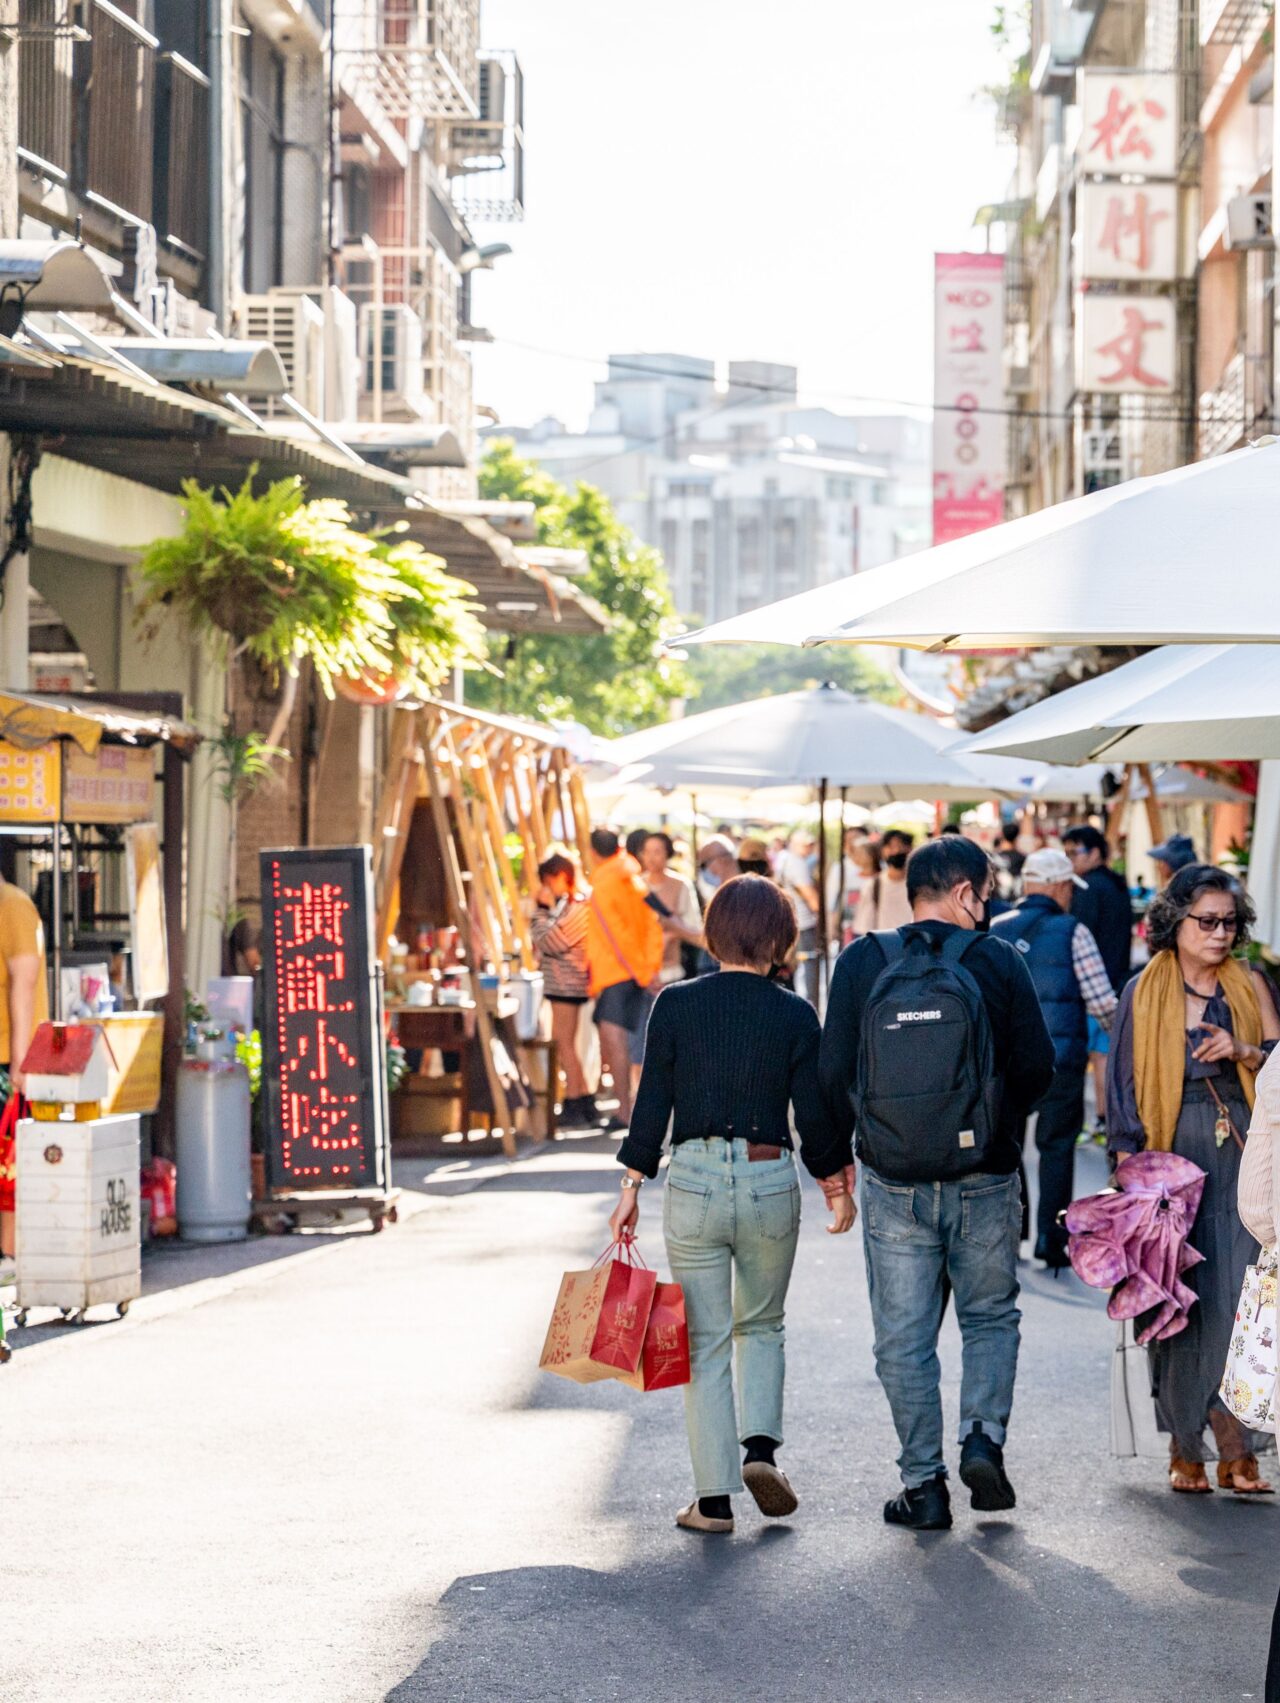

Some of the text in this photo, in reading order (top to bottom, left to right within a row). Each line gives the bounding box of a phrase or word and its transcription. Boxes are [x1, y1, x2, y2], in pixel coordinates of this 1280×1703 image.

[283, 882, 359, 1149] 黃記小吃
[896, 1010, 942, 1021] SKECHERS
[107, 1178, 126, 1205] OLD
[101, 1204, 131, 1239] HOUSE
